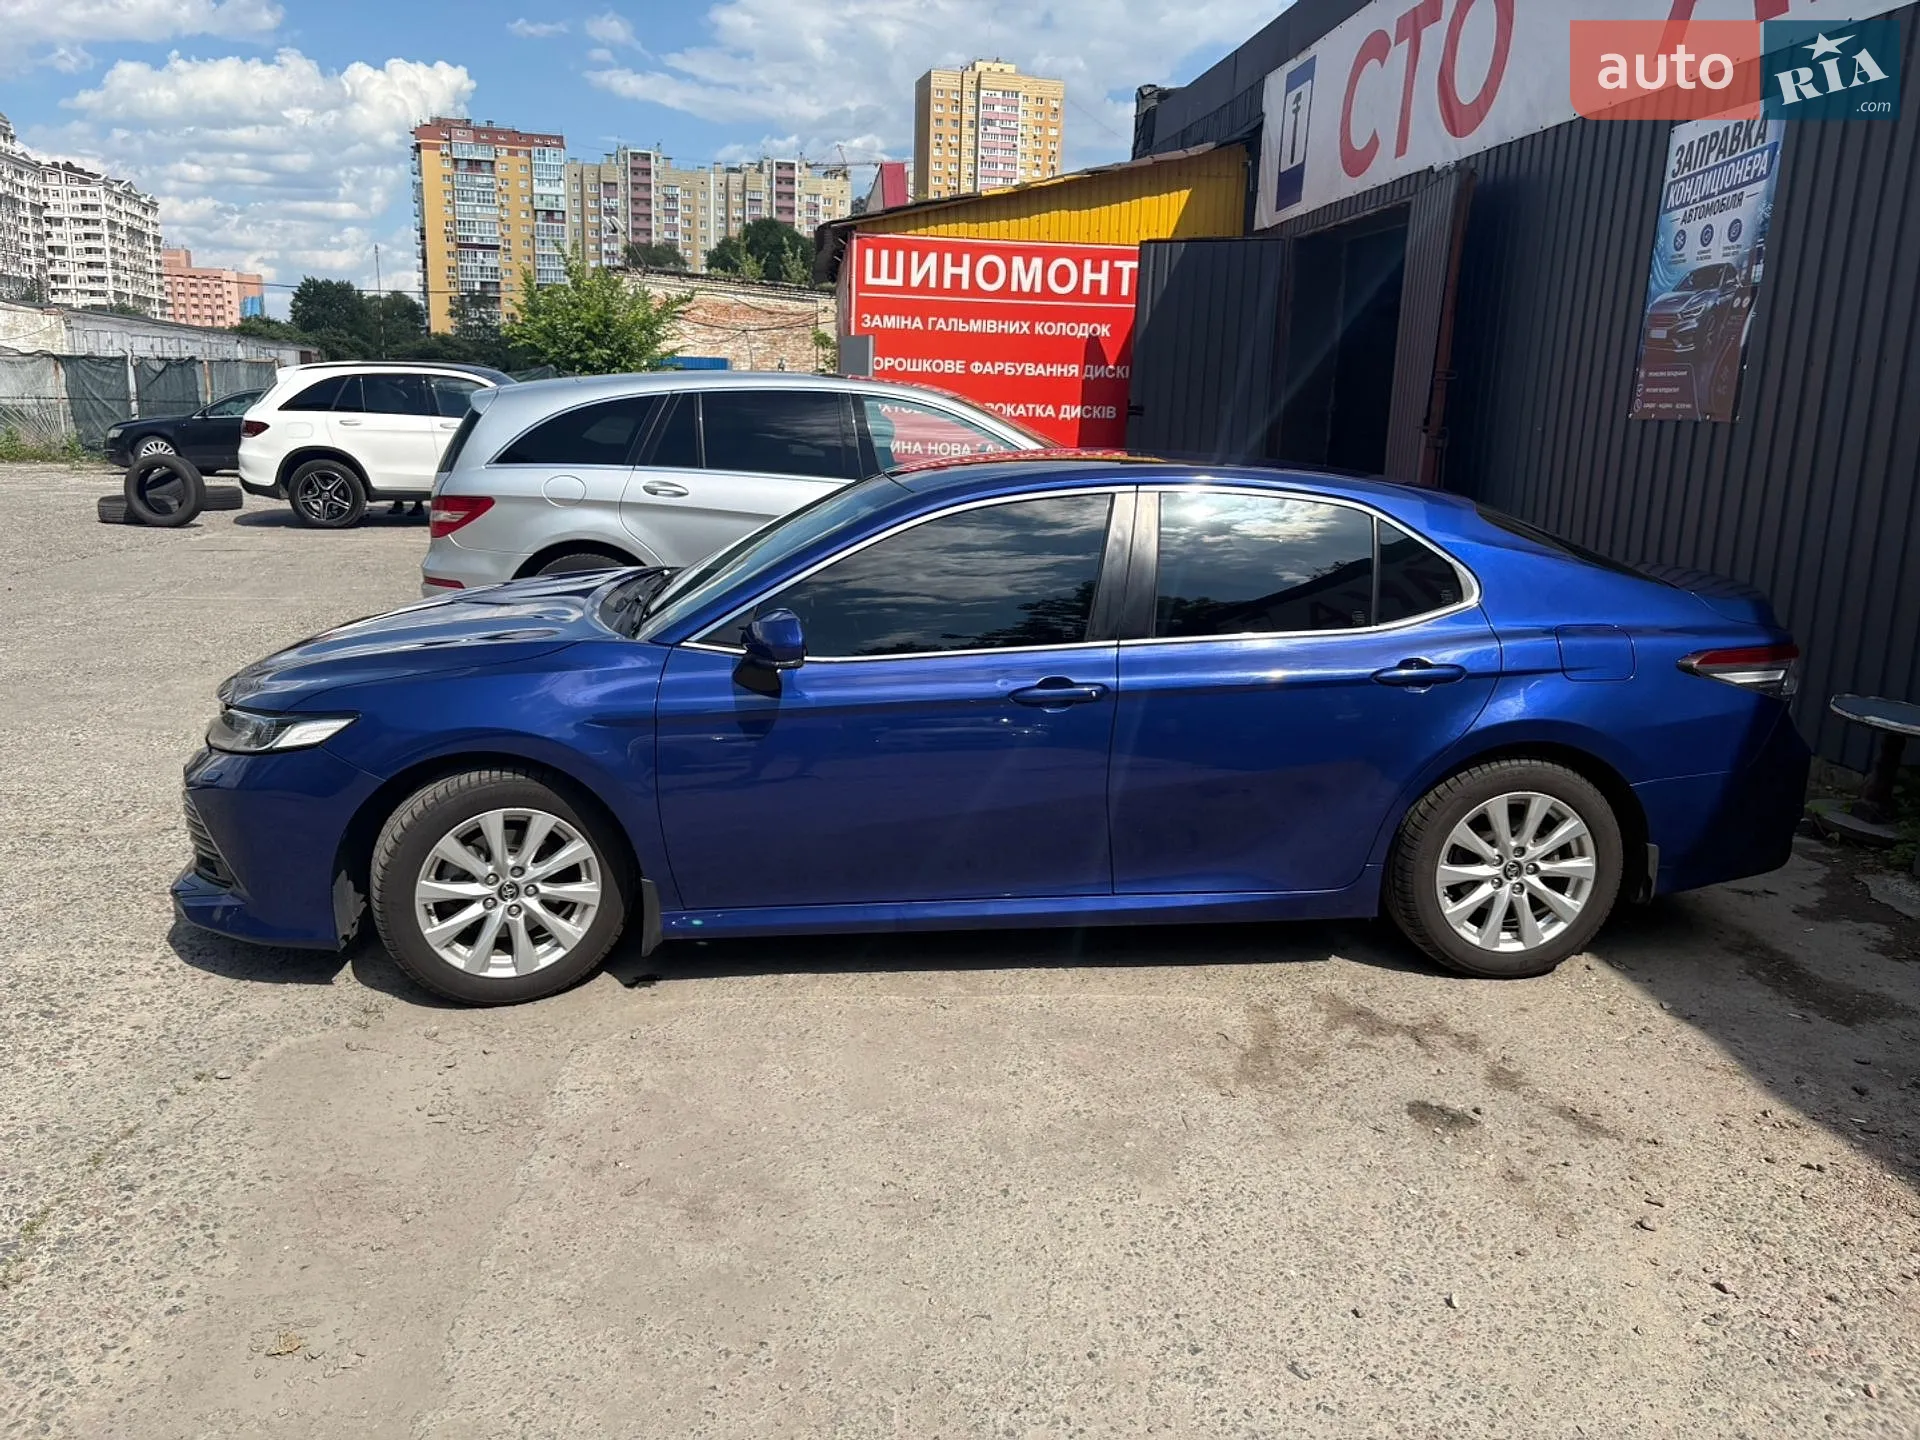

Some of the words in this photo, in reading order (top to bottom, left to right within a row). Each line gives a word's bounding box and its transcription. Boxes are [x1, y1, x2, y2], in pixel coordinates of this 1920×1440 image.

[1340, 0, 1514, 178] СТО
[1672, 110, 1769, 178] ЗАПРАВКА
[1666, 149, 1769, 209] КОНДИЦІОНЕРА
[1680, 191, 1745, 225] АВТОМОБІЛЯ
[864, 248, 1139, 296] ШИНОМОНТ
[861, 313, 924, 330] ЗАМІНА
[928, 317, 1031, 335] ГАЛЬМІВНИХ
[1034, 322, 1112, 338] КОЛОДОК
[873, 356, 966, 374] ОРОШКОВЕ
[969, 360, 1079, 377] ФАРБУВАННЯ
[1082, 363, 1130, 379] ДИСКІ
[985, 402, 1056, 418] ОКАТКА
[1058, 404, 1117, 420] ДИСКІВ
[890, 439, 923, 454] ИНА
[928, 441, 972, 456] НОВА
